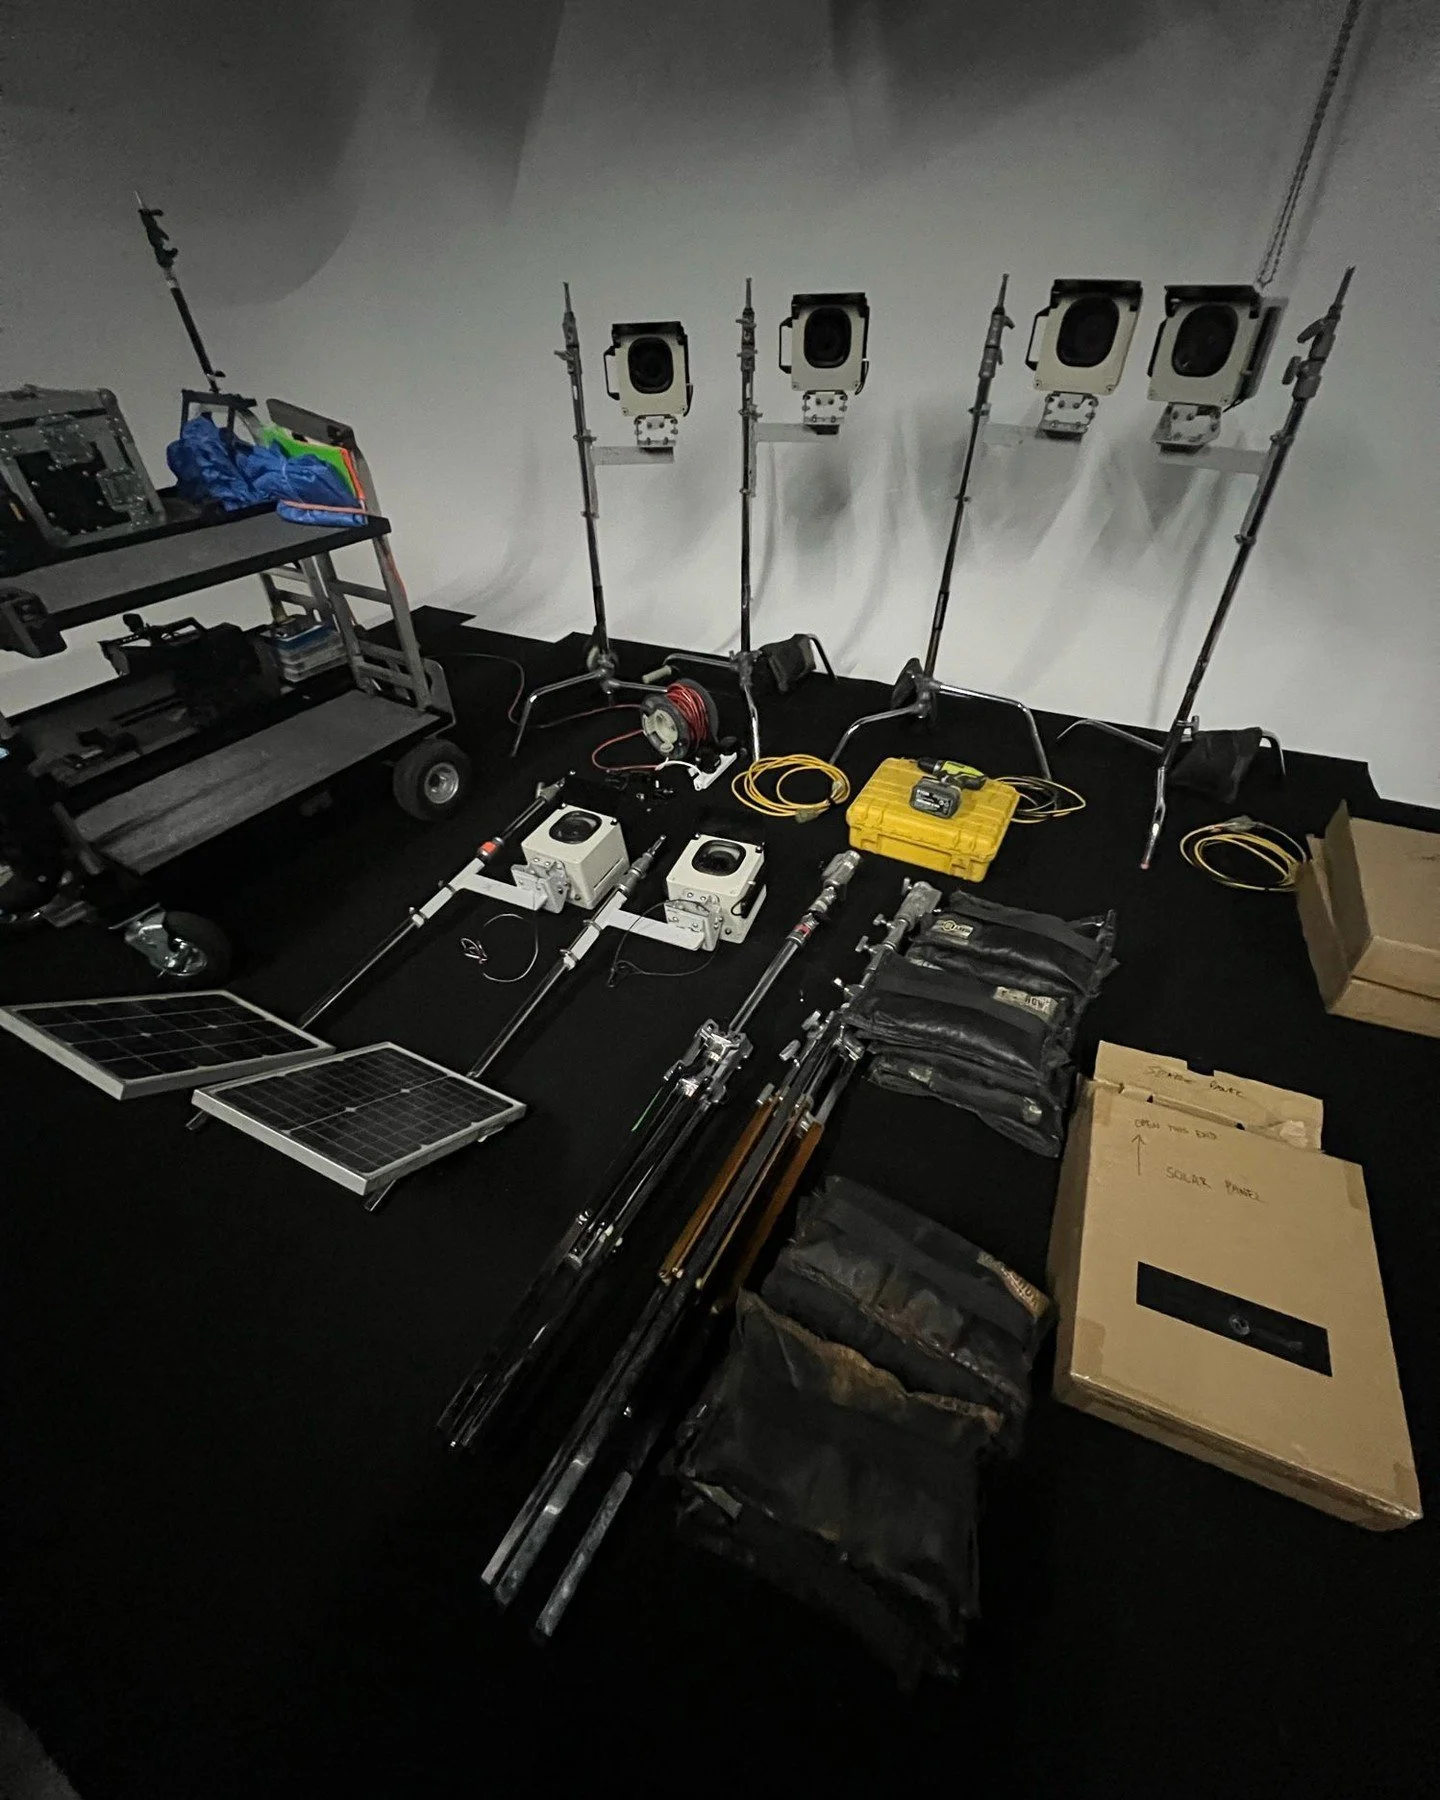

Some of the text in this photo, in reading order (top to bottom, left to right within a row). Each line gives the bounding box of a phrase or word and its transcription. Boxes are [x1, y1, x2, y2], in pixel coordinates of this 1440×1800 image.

[1134, 1118, 1160, 1129] OPEN
[1168, 1124, 1189, 1135] THIS
[1165, 1166, 1266, 1203] SOLAR PANEL
